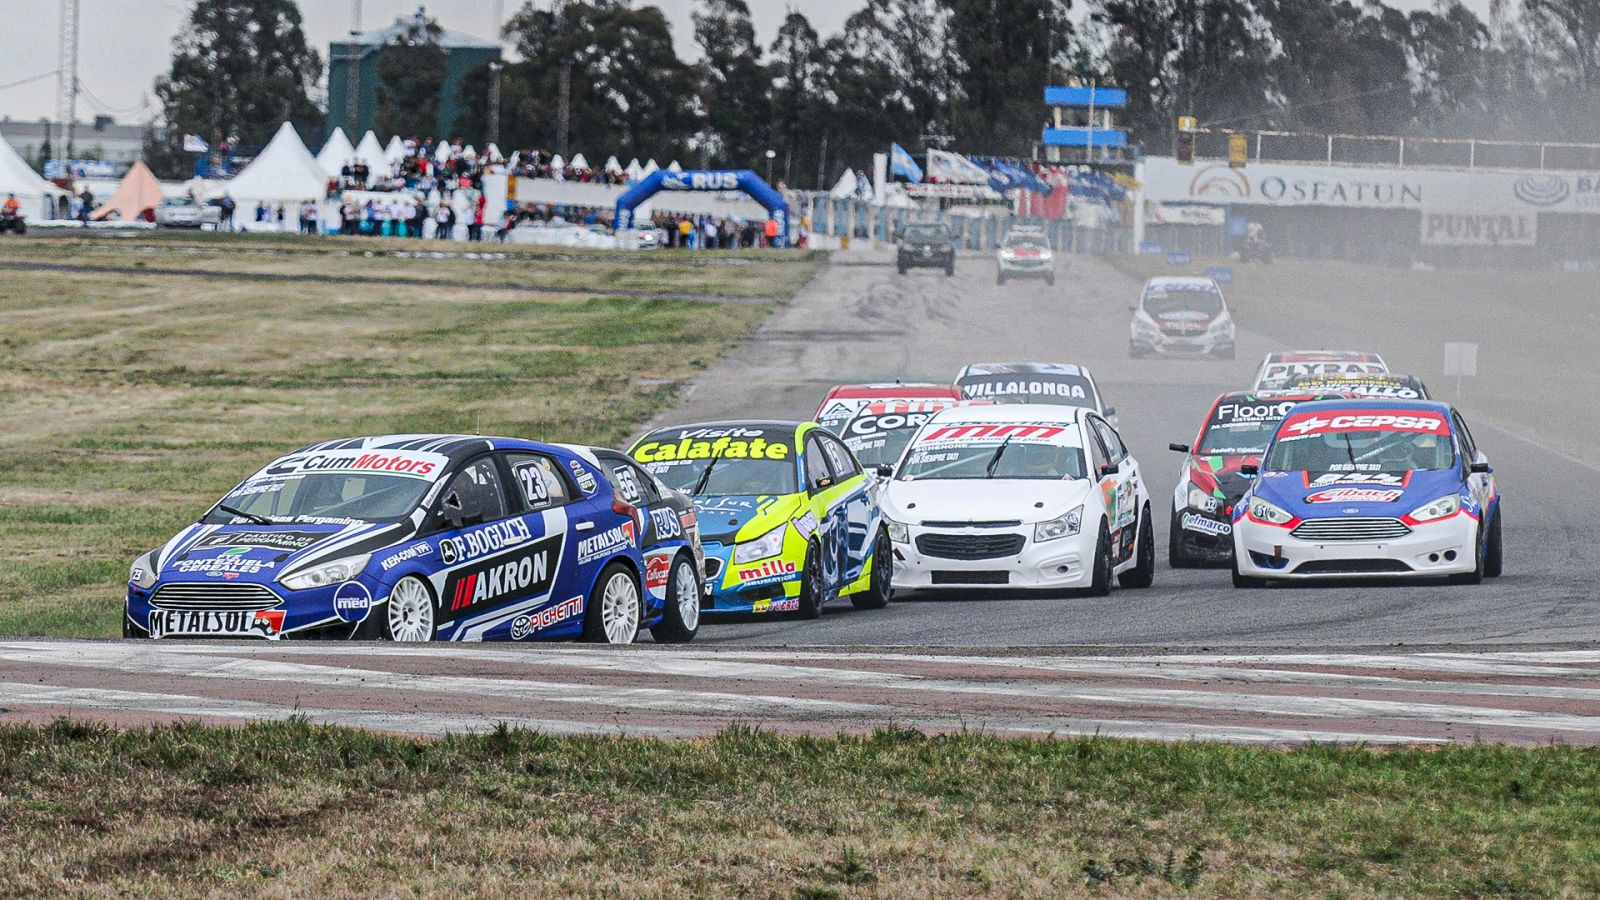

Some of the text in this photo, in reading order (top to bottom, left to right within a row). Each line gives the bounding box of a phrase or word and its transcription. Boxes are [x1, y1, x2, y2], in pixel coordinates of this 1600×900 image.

[691, 173, 738, 188] RUS
[1260, 174, 1422, 202] OSFATUN
[1426, 213, 1530, 240] PUNTAL
[965, 381, 1085, 399] VILLALONGA
[1330, 415, 1442, 430] CEPSA
[634, 436, 789, 463] Calafate
[302, 454, 436, 475] CumMotors
[519, 467, 547, 500] 23
[615, 471, 638, 500] 56
[652, 508, 680, 539] RUS
[237, 538, 310, 548] PERGAMINO
[243, 533, 295, 541] PARTIDO
[578, 526, 624, 559] METALSOL
[132, 569, 143, 581] 23
[172, 559, 276, 569] FONTEZUELA
[178, 564, 262, 575] CEREALES
[739, 558, 796, 580] milla
[472, 550, 548, 604] AKRON
[337, 598, 368, 610] med
[530, 596, 583, 632] PICHETTI
[150, 610, 250, 637] METALSOL
